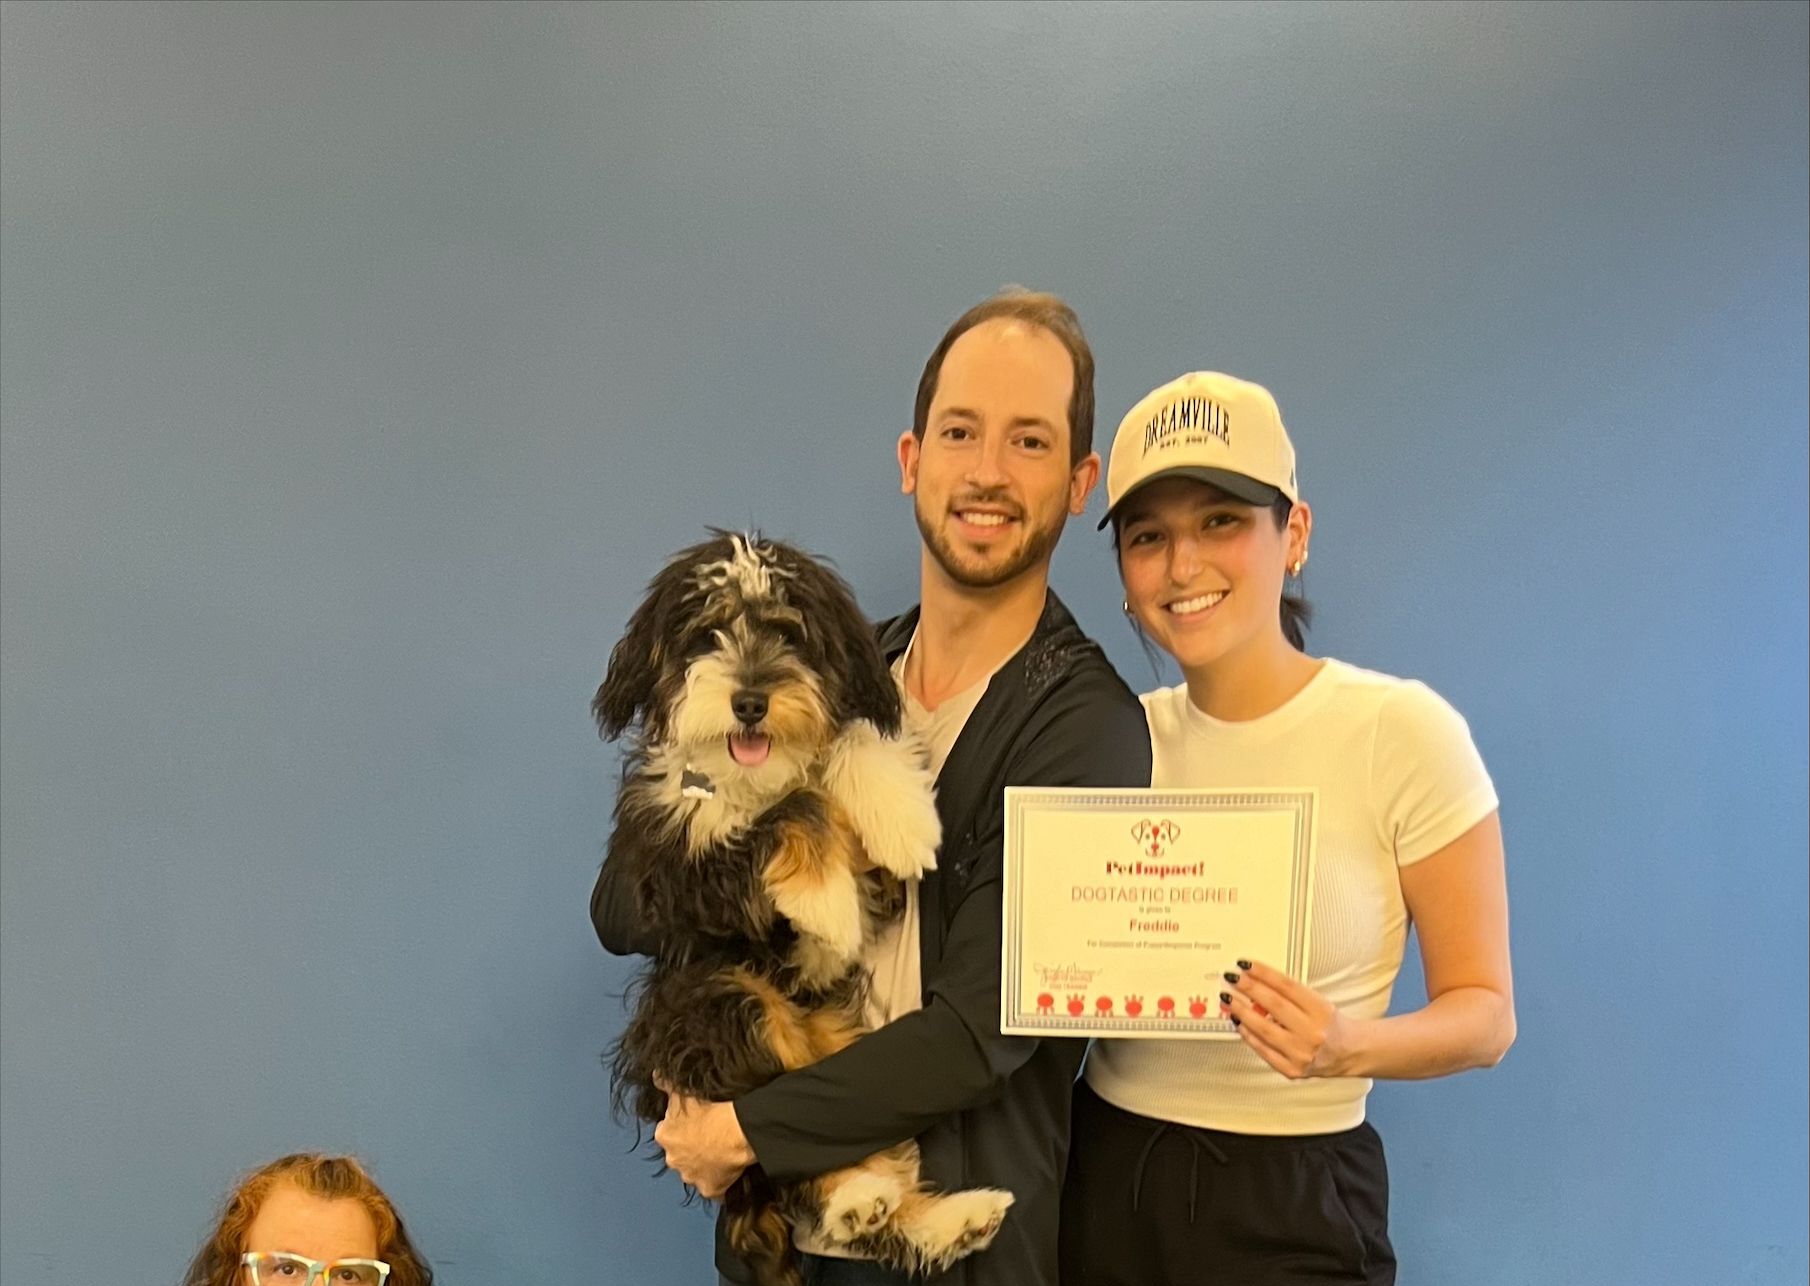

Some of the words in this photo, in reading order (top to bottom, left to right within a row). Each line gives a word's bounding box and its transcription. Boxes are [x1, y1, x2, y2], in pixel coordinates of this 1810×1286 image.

[1142, 396, 1230, 458] DREAMVILLE
[1071, 886, 1165, 903] DOGTASTIC
[1169, 886, 1239, 904] DEGREE
